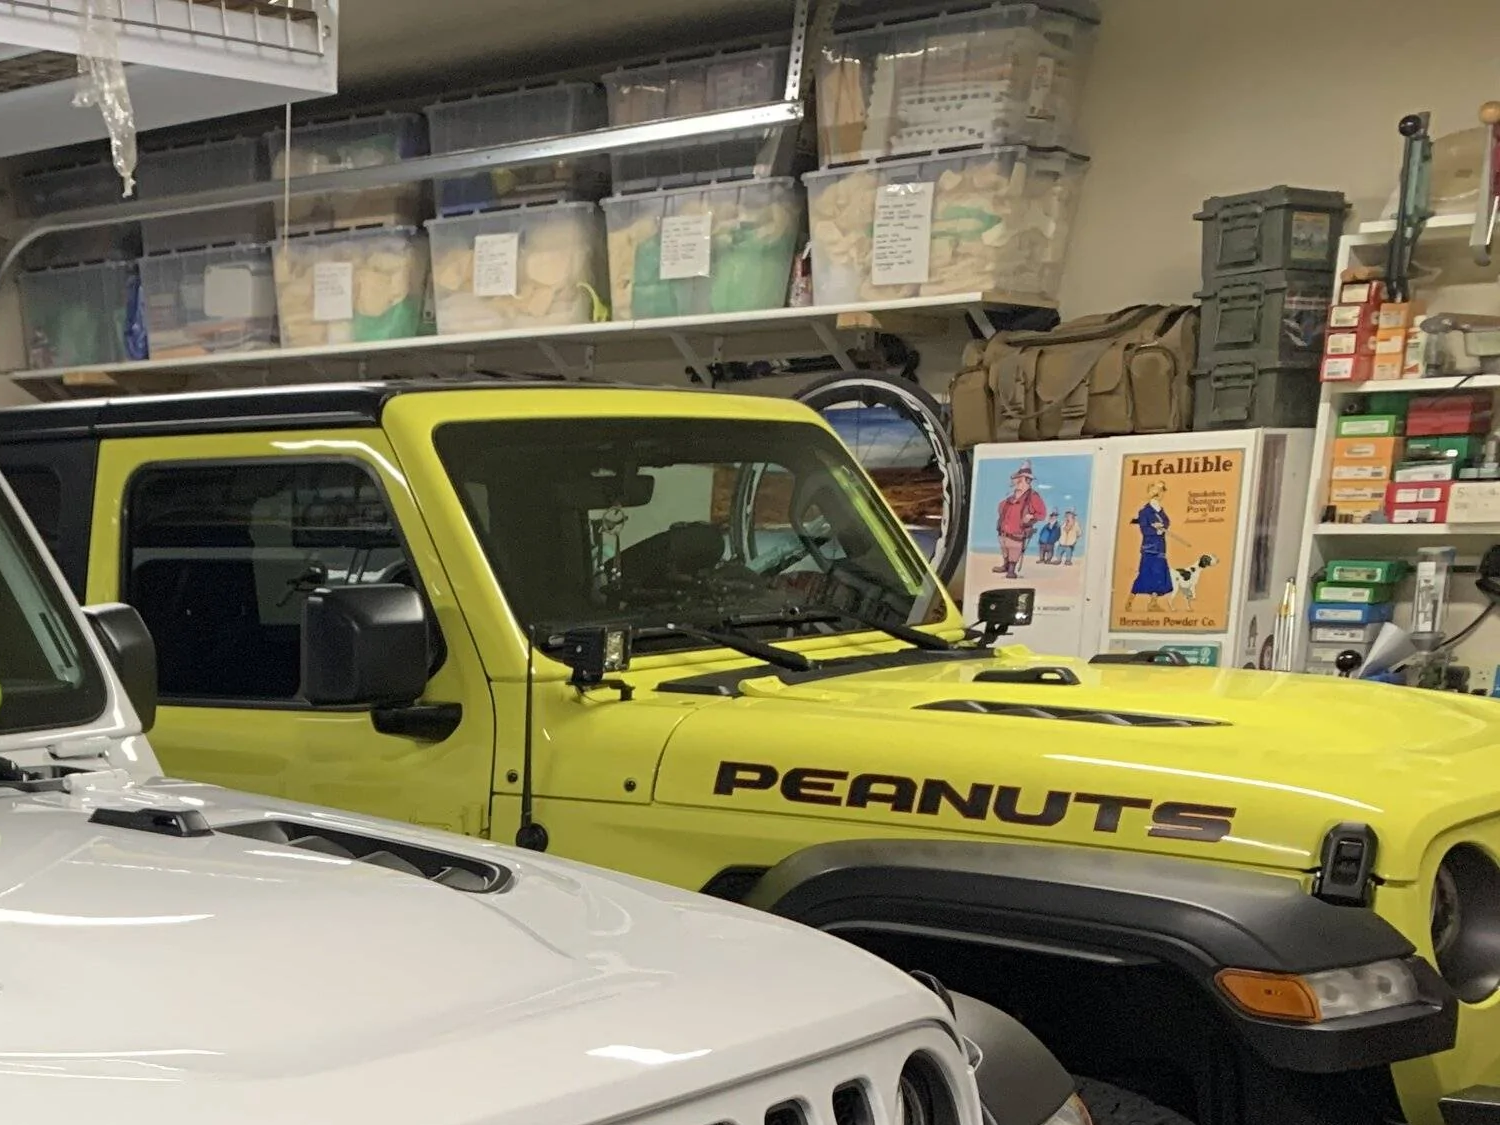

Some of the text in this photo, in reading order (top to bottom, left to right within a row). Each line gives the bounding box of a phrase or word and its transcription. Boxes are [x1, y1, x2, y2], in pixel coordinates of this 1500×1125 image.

[1131, 455, 1233, 476] Infallible
[1186, 505, 1227, 513] Powder
[1119, 616, 1216, 626] Hercules Powder Co.
[713, 760, 1237, 842] PEANUTS
